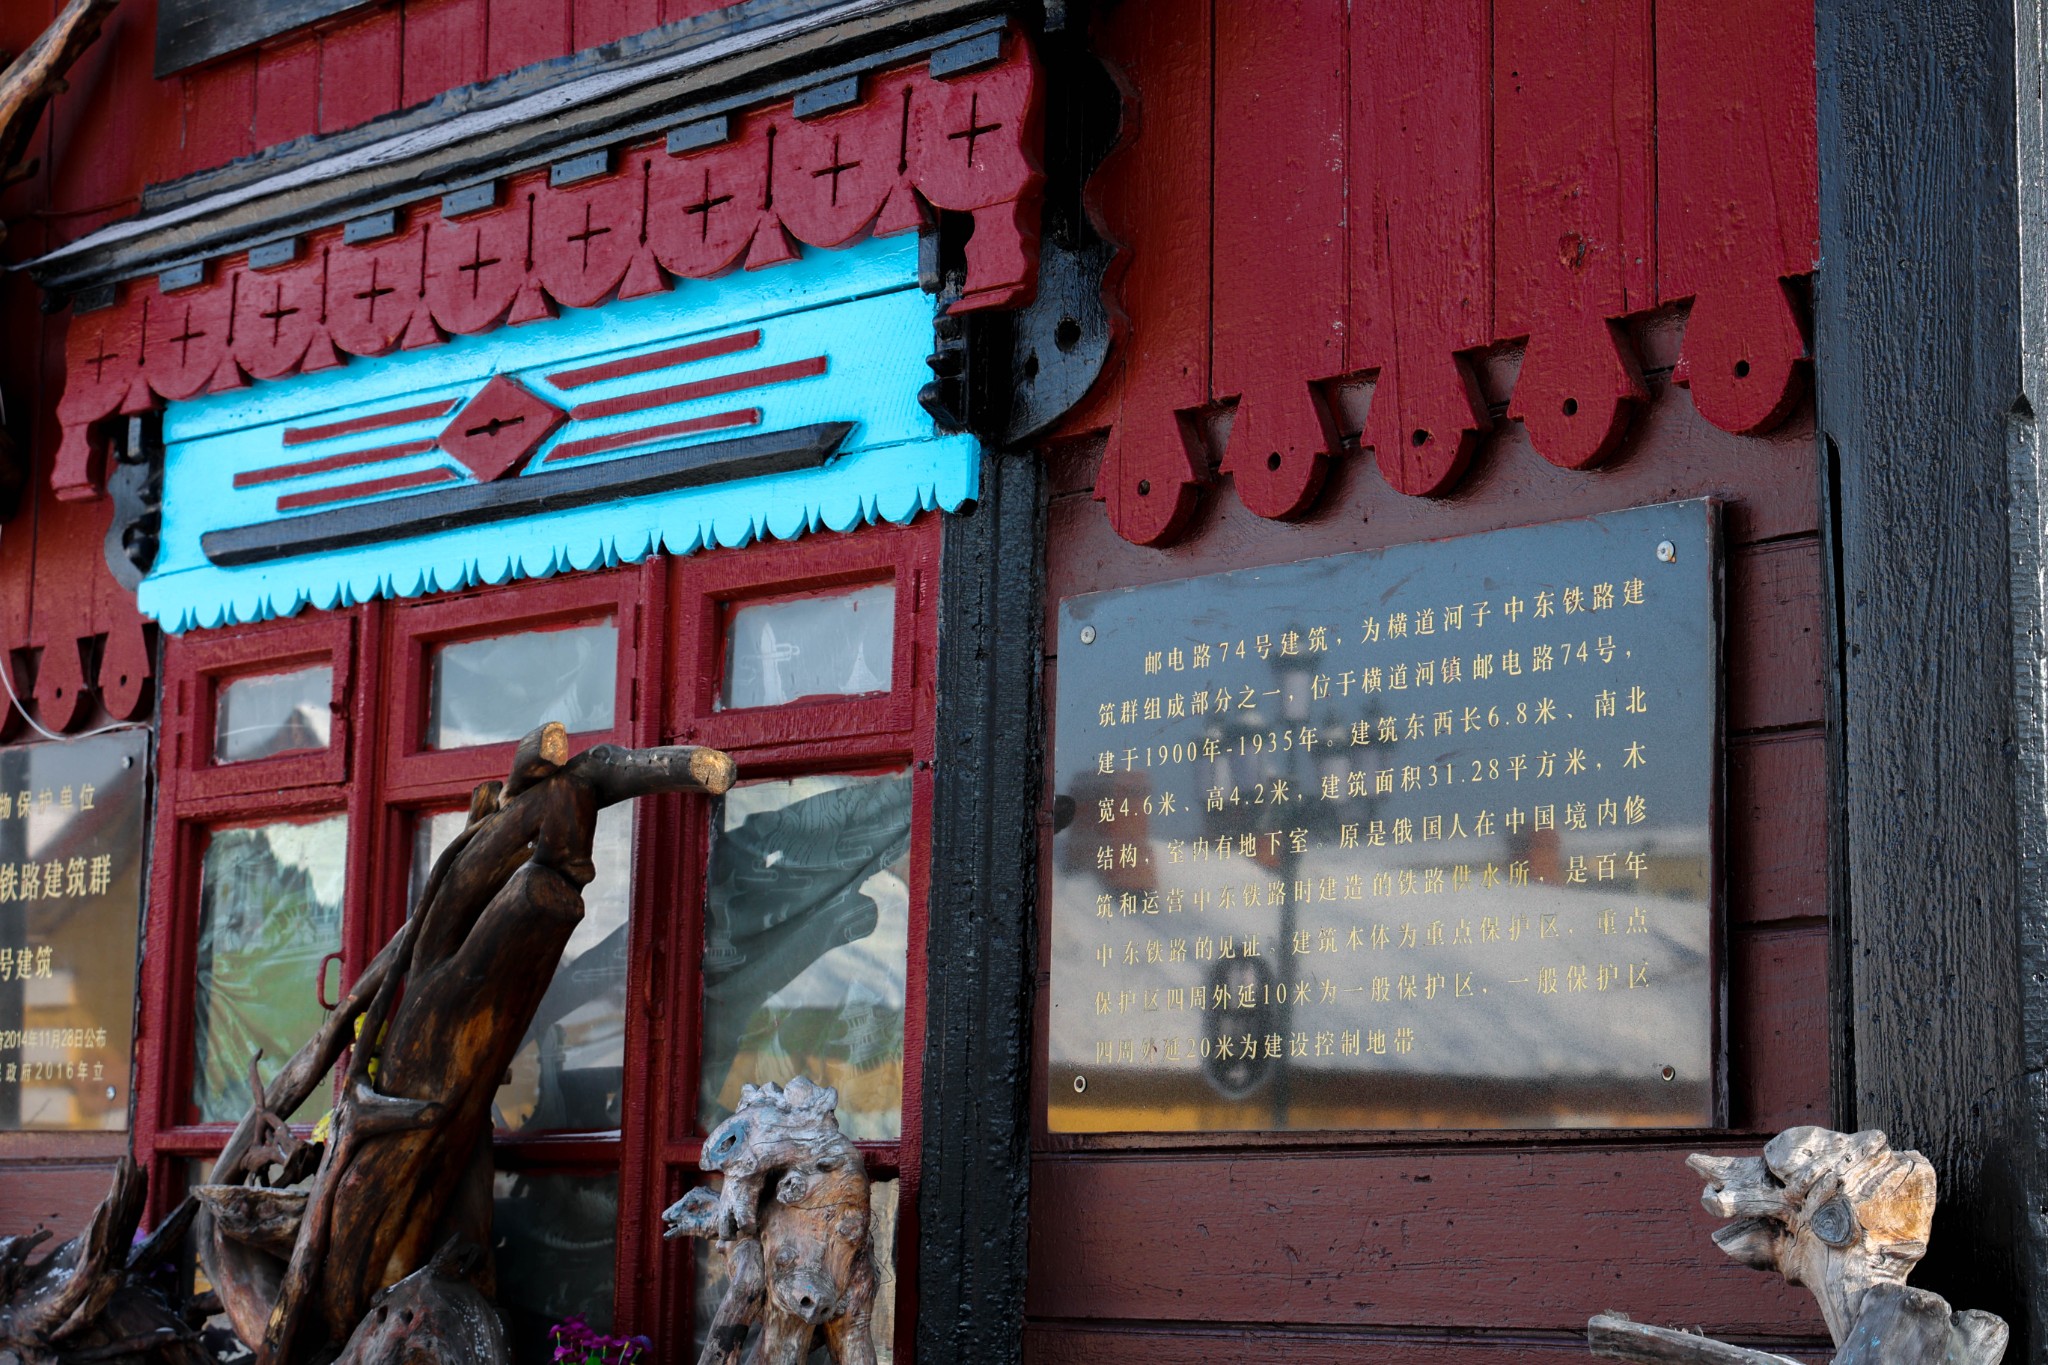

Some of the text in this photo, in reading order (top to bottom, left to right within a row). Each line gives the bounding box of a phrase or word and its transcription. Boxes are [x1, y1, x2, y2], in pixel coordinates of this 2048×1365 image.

[1144, 577, 1646, 675] 邮电路74号建筑，为横道河子中东铁路建
[0, 853, 112, 904] 铁路建筑群
[0, 945, 54, 982] 号建筑
[0, 1060, 104, 1083] 政府2016年立
